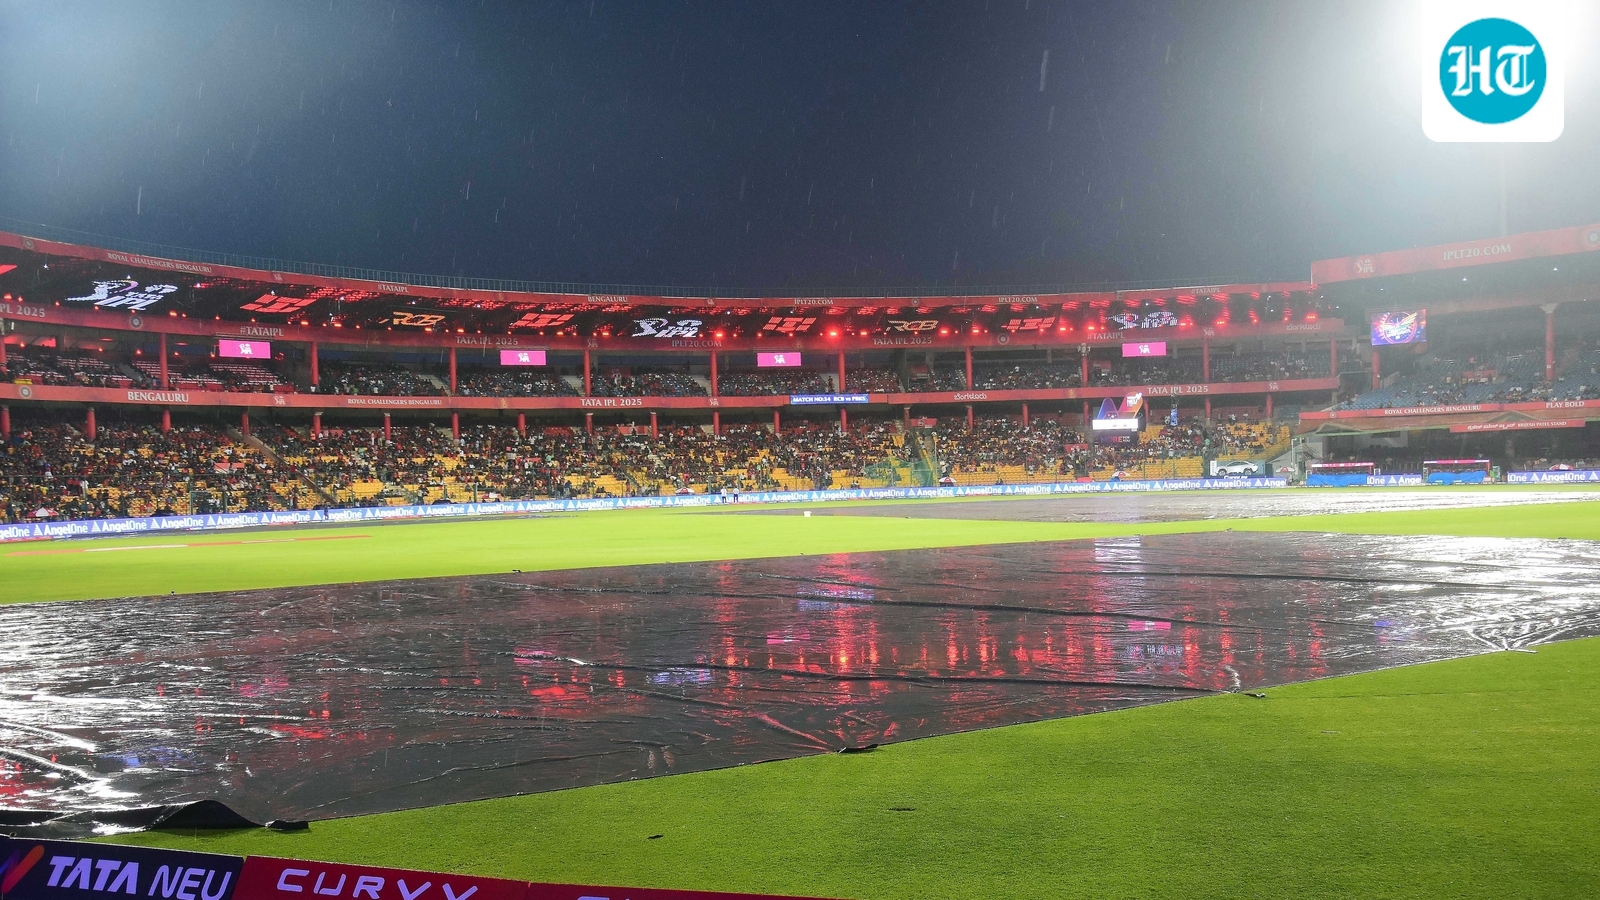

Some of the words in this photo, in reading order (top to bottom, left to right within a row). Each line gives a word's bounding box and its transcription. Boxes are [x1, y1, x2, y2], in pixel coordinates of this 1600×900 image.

[1443, 244, 1511, 261] IPLT20.COM
[107, 253, 129, 261] ROYAL
[130, 256, 174, 269] CHALLENGERS
[175, 263, 212, 273] BENGALURU
[16, 305, 46, 317] 2025
[240, 326, 284, 336] #TATAIPL
[1087, 332, 1125, 340] #TATAIPL
[456, 336, 478, 345] TATA
[479, 337, 492, 345] IPL
[495, 337, 518, 346] 2025
[671, 340, 722, 348] IPLT20.COM
[895, 337, 908, 345] IPL
[1170, 386, 1184, 394] IPL
[1186, 385, 1209, 393] 2025
[127, 391, 189, 402] BENGALURU
[580, 398, 602, 406] TATA
[620, 398, 642, 406] 2025
[1384, 408, 1402, 416] ROYAL
[1541, 471, 1586, 483] AngelOne
[1014, 484, 1052, 494] AngelOne
[1062, 482, 1101, 494] AngelOne
[1112, 481, 1151, 492] AngelOne
[1162, 479, 1200, 490] AngelOne
[1212, 478, 1251, 489] AngelOne
[820, 489, 857, 501] AngelOne
[868, 489, 905, 500] AngelOne
[917, 487, 953, 499] AngelOne
[965, 486, 1002, 497] AngelOne
[626, 496, 666, 507] AngelOne
[675, 495, 711, 506] AngelOne
[771, 492, 808, 503] AngelOne
[476, 503, 514, 513] AngelOne
[526, 501, 564, 511] AngelOne
[576, 499, 614, 509] AngelOne
[374, 507, 414, 519] AngelOne
[426, 505, 464, 516] AngelOne
[217, 511, 258, 525] AngelOne
[270, 511, 310, 523] AngelOne
[102, 520, 147, 533] AngelOne
[161, 517, 204, 529] AngelOne
[44, 523, 88, 536] AngelOne
[47, 855, 140, 894] TATA
[147, 864, 232, 900] NEU
